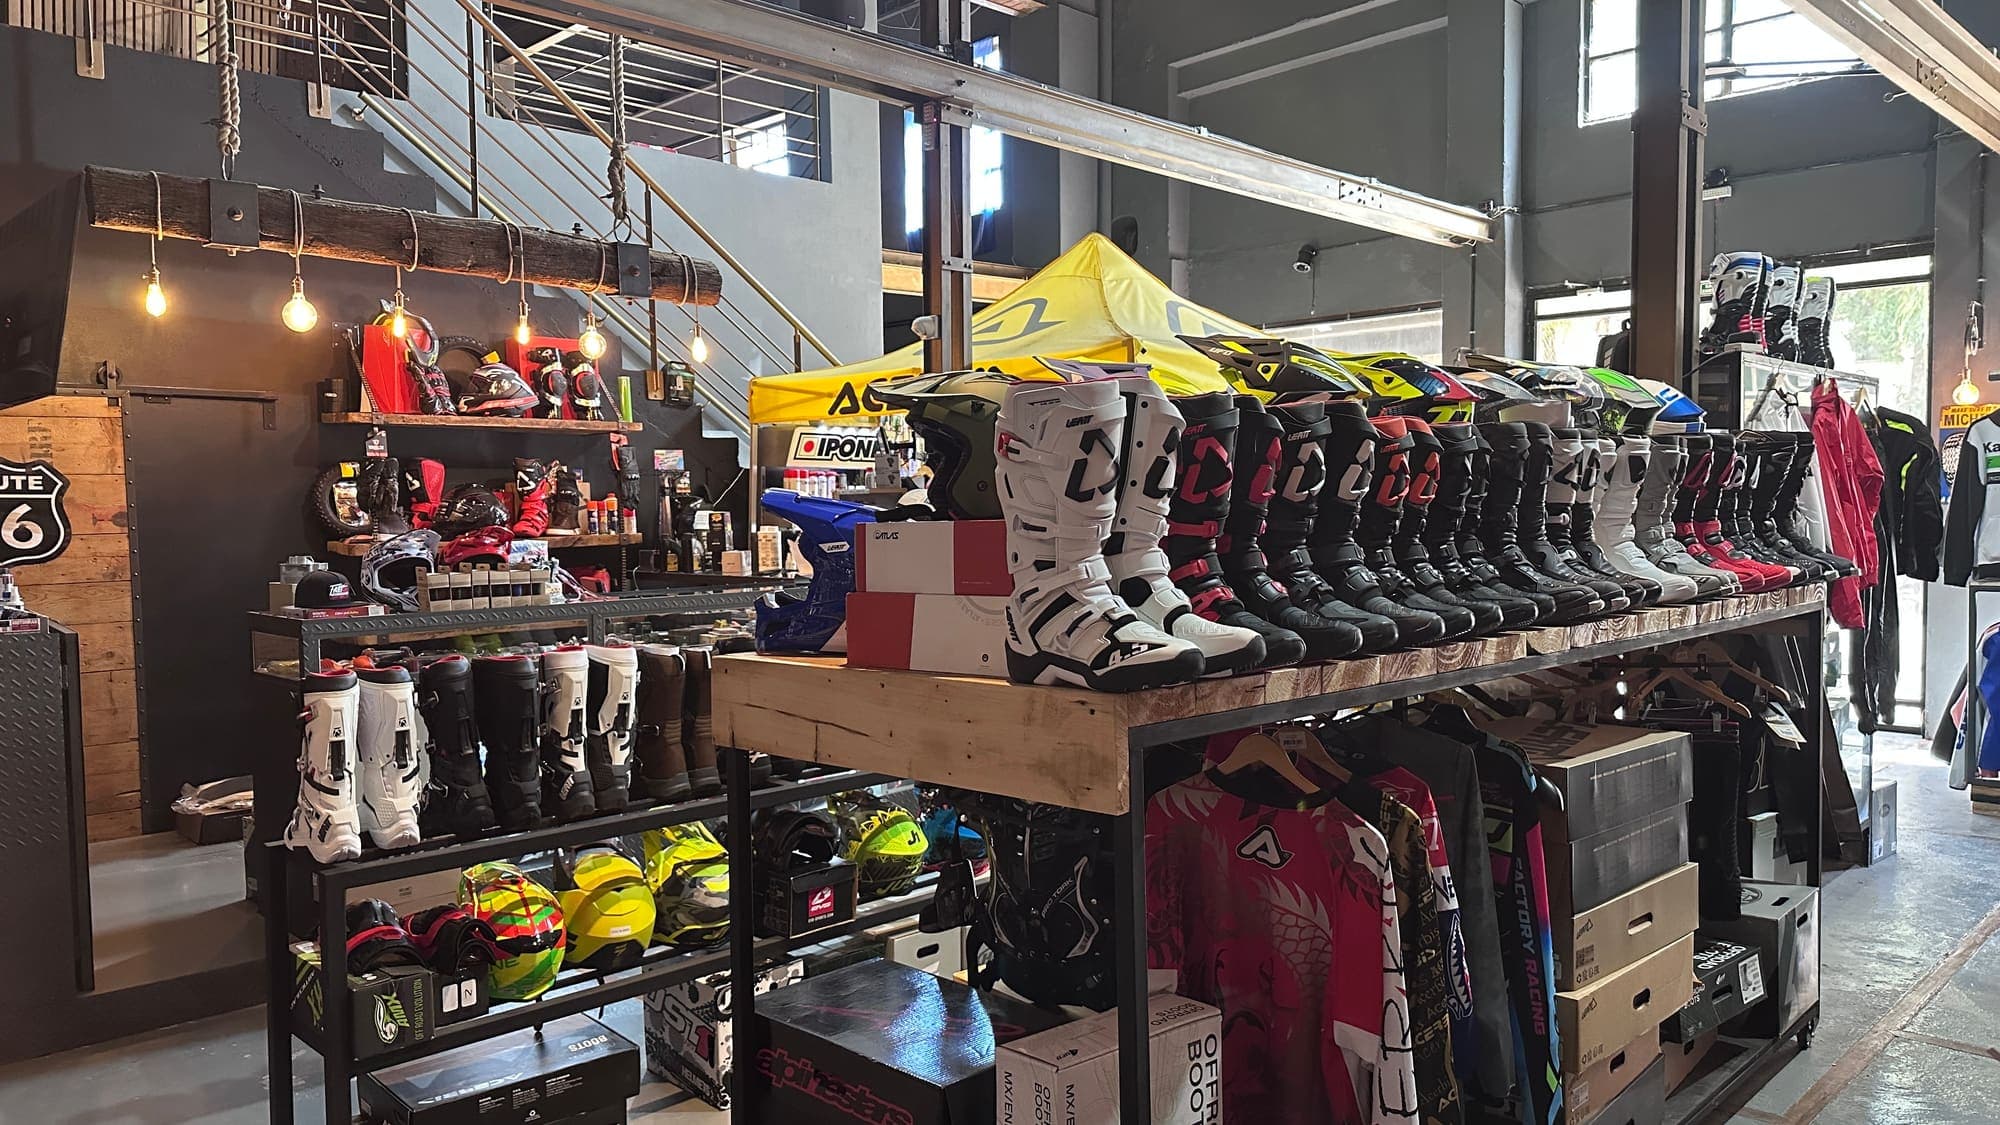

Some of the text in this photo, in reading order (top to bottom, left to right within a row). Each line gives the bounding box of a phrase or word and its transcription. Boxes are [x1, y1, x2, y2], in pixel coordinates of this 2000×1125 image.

[1209, 347, 1234, 356] UFO
[1066, 415, 1094, 428] LEATT
[1288, 429, 1312, 441] LEATT
[1108, 644, 1149, 667] 4.5
[1041, 877, 1074, 919] PRO TORK
[1513, 857, 1546, 1037] FACTORY RACING
[412, 978, 425, 1041] OFF ROAD EVOLUTION
[567, 1035, 609, 1053] BOOTS
[1204, 1033, 1219, 1125] OFFR
[1004, 1071, 1013, 1125] MX/EN
